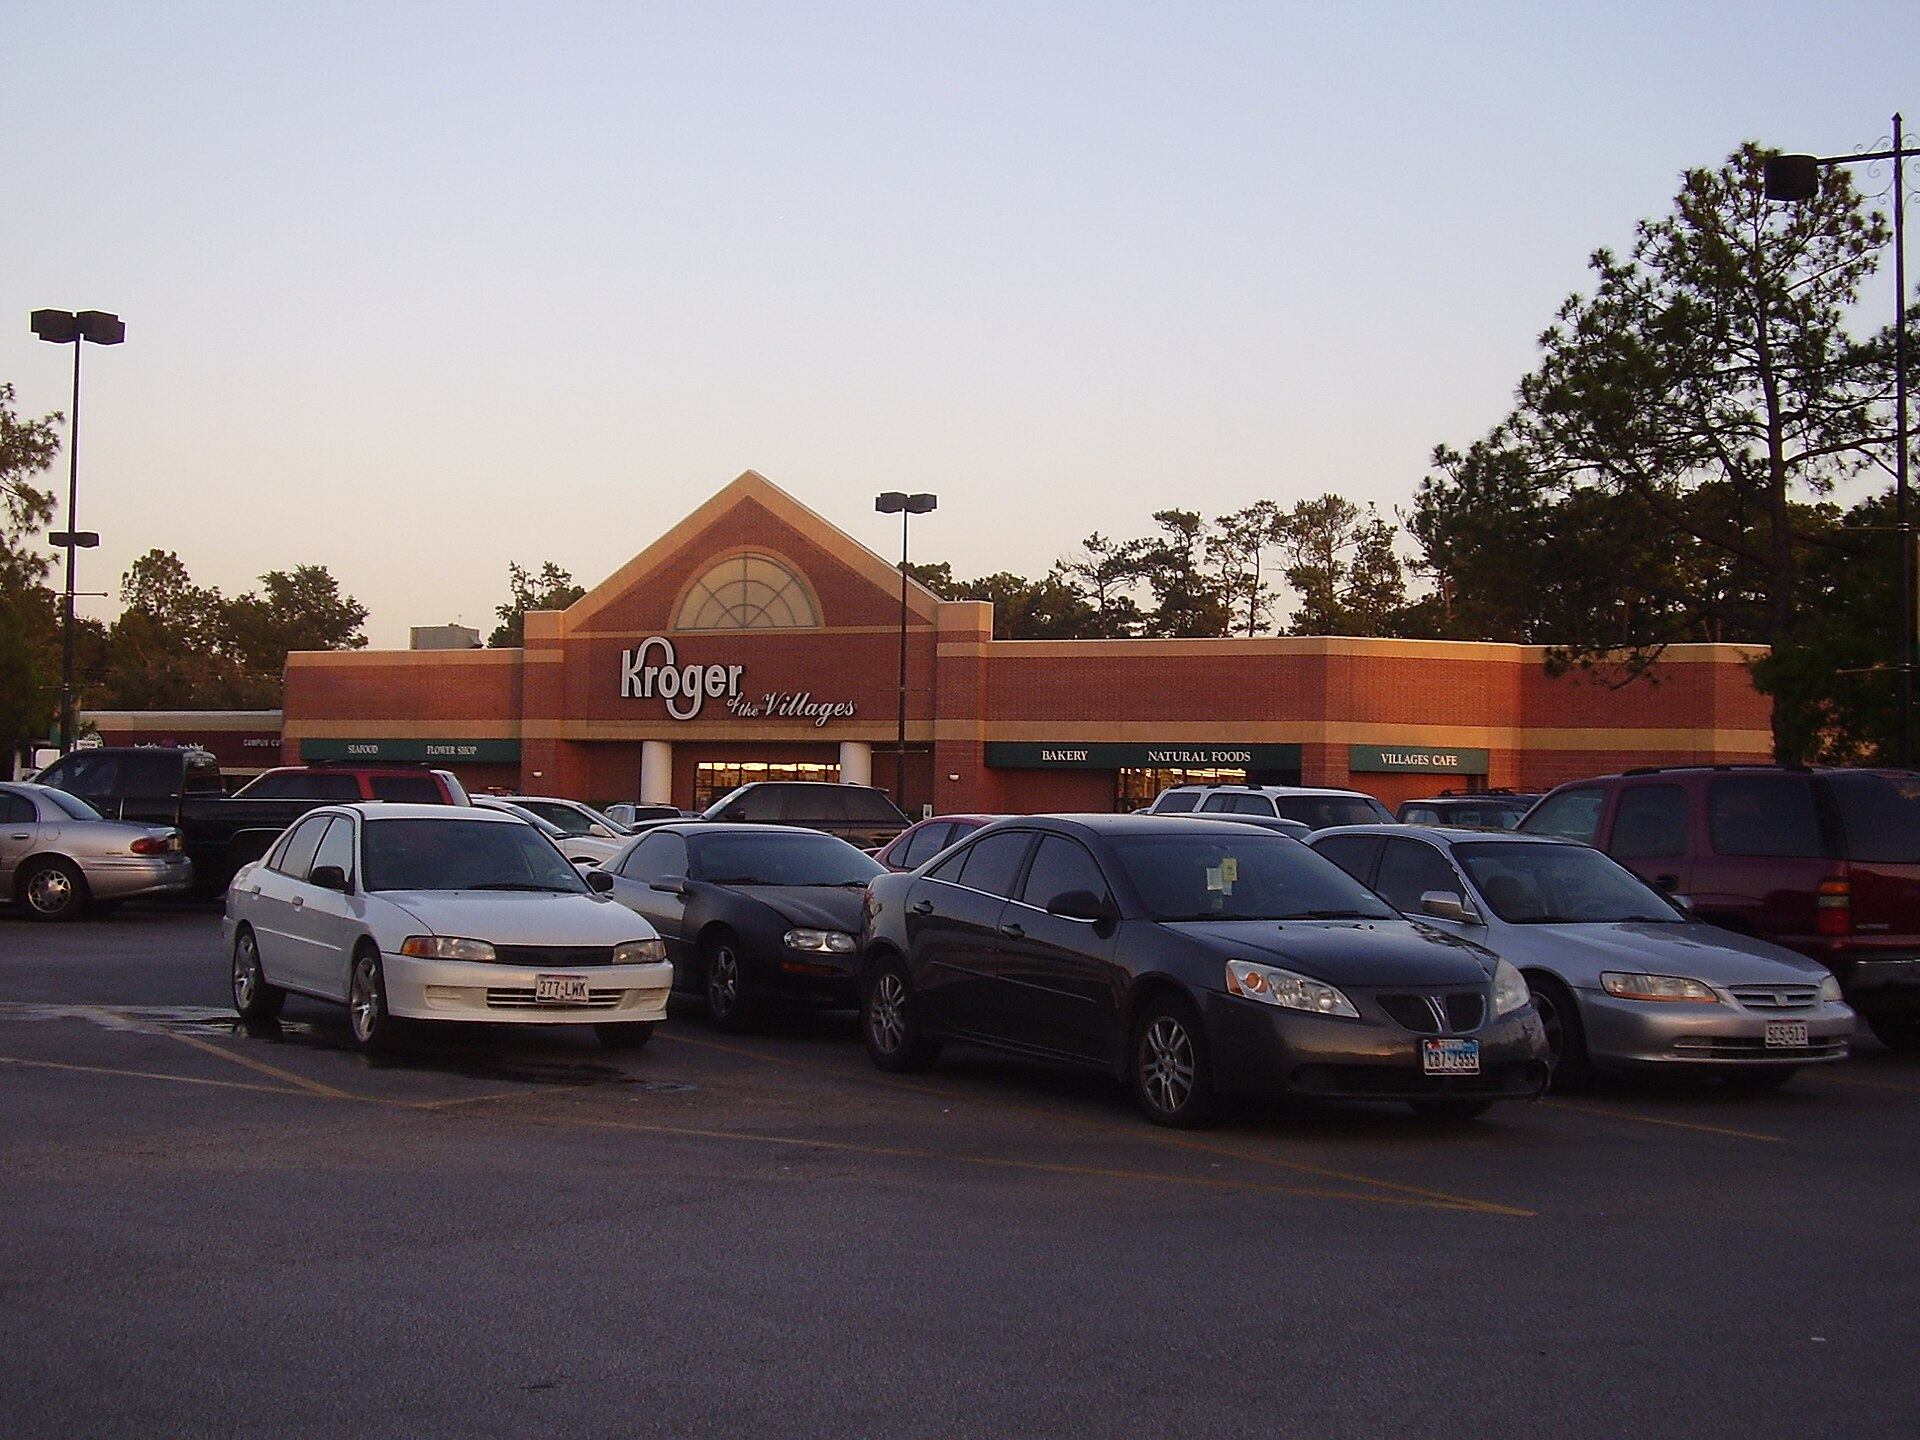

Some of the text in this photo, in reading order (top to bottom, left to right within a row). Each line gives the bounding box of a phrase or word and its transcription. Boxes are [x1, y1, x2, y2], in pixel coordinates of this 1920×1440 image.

[620, 636, 743, 720] Kroger
[726, 691, 855, 727] of the Villages
[347, 744, 378, 754] SEAFOOD
[426, 745, 477, 755] FLOWER SHOP
[1041, 749, 1088, 762] BAKERY
[1147, 749, 1251, 763] NATURAL FOODS
[1381, 752, 1458, 767] VILLAGES CAFE
